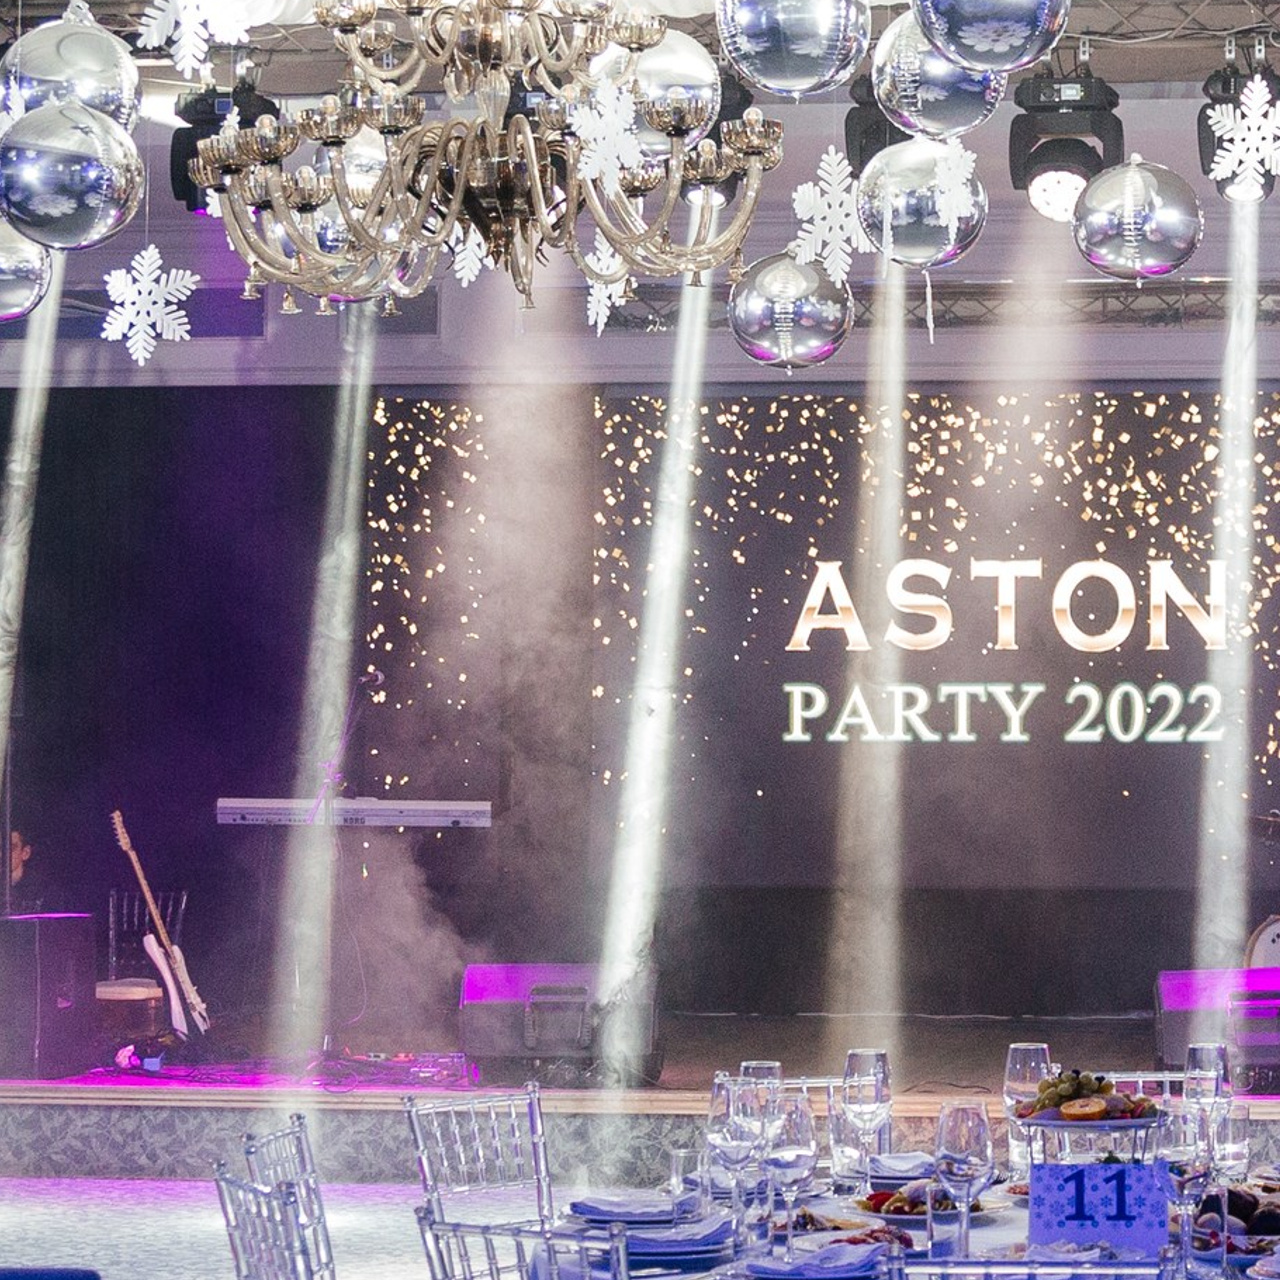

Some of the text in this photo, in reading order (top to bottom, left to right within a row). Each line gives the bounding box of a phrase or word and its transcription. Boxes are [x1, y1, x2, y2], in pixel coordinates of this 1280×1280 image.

[785, 557, 1228, 652] ASTON
[783, 683, 1225, 743] PARTY 2022
[1063, 1168, 1137, 1221] 11
